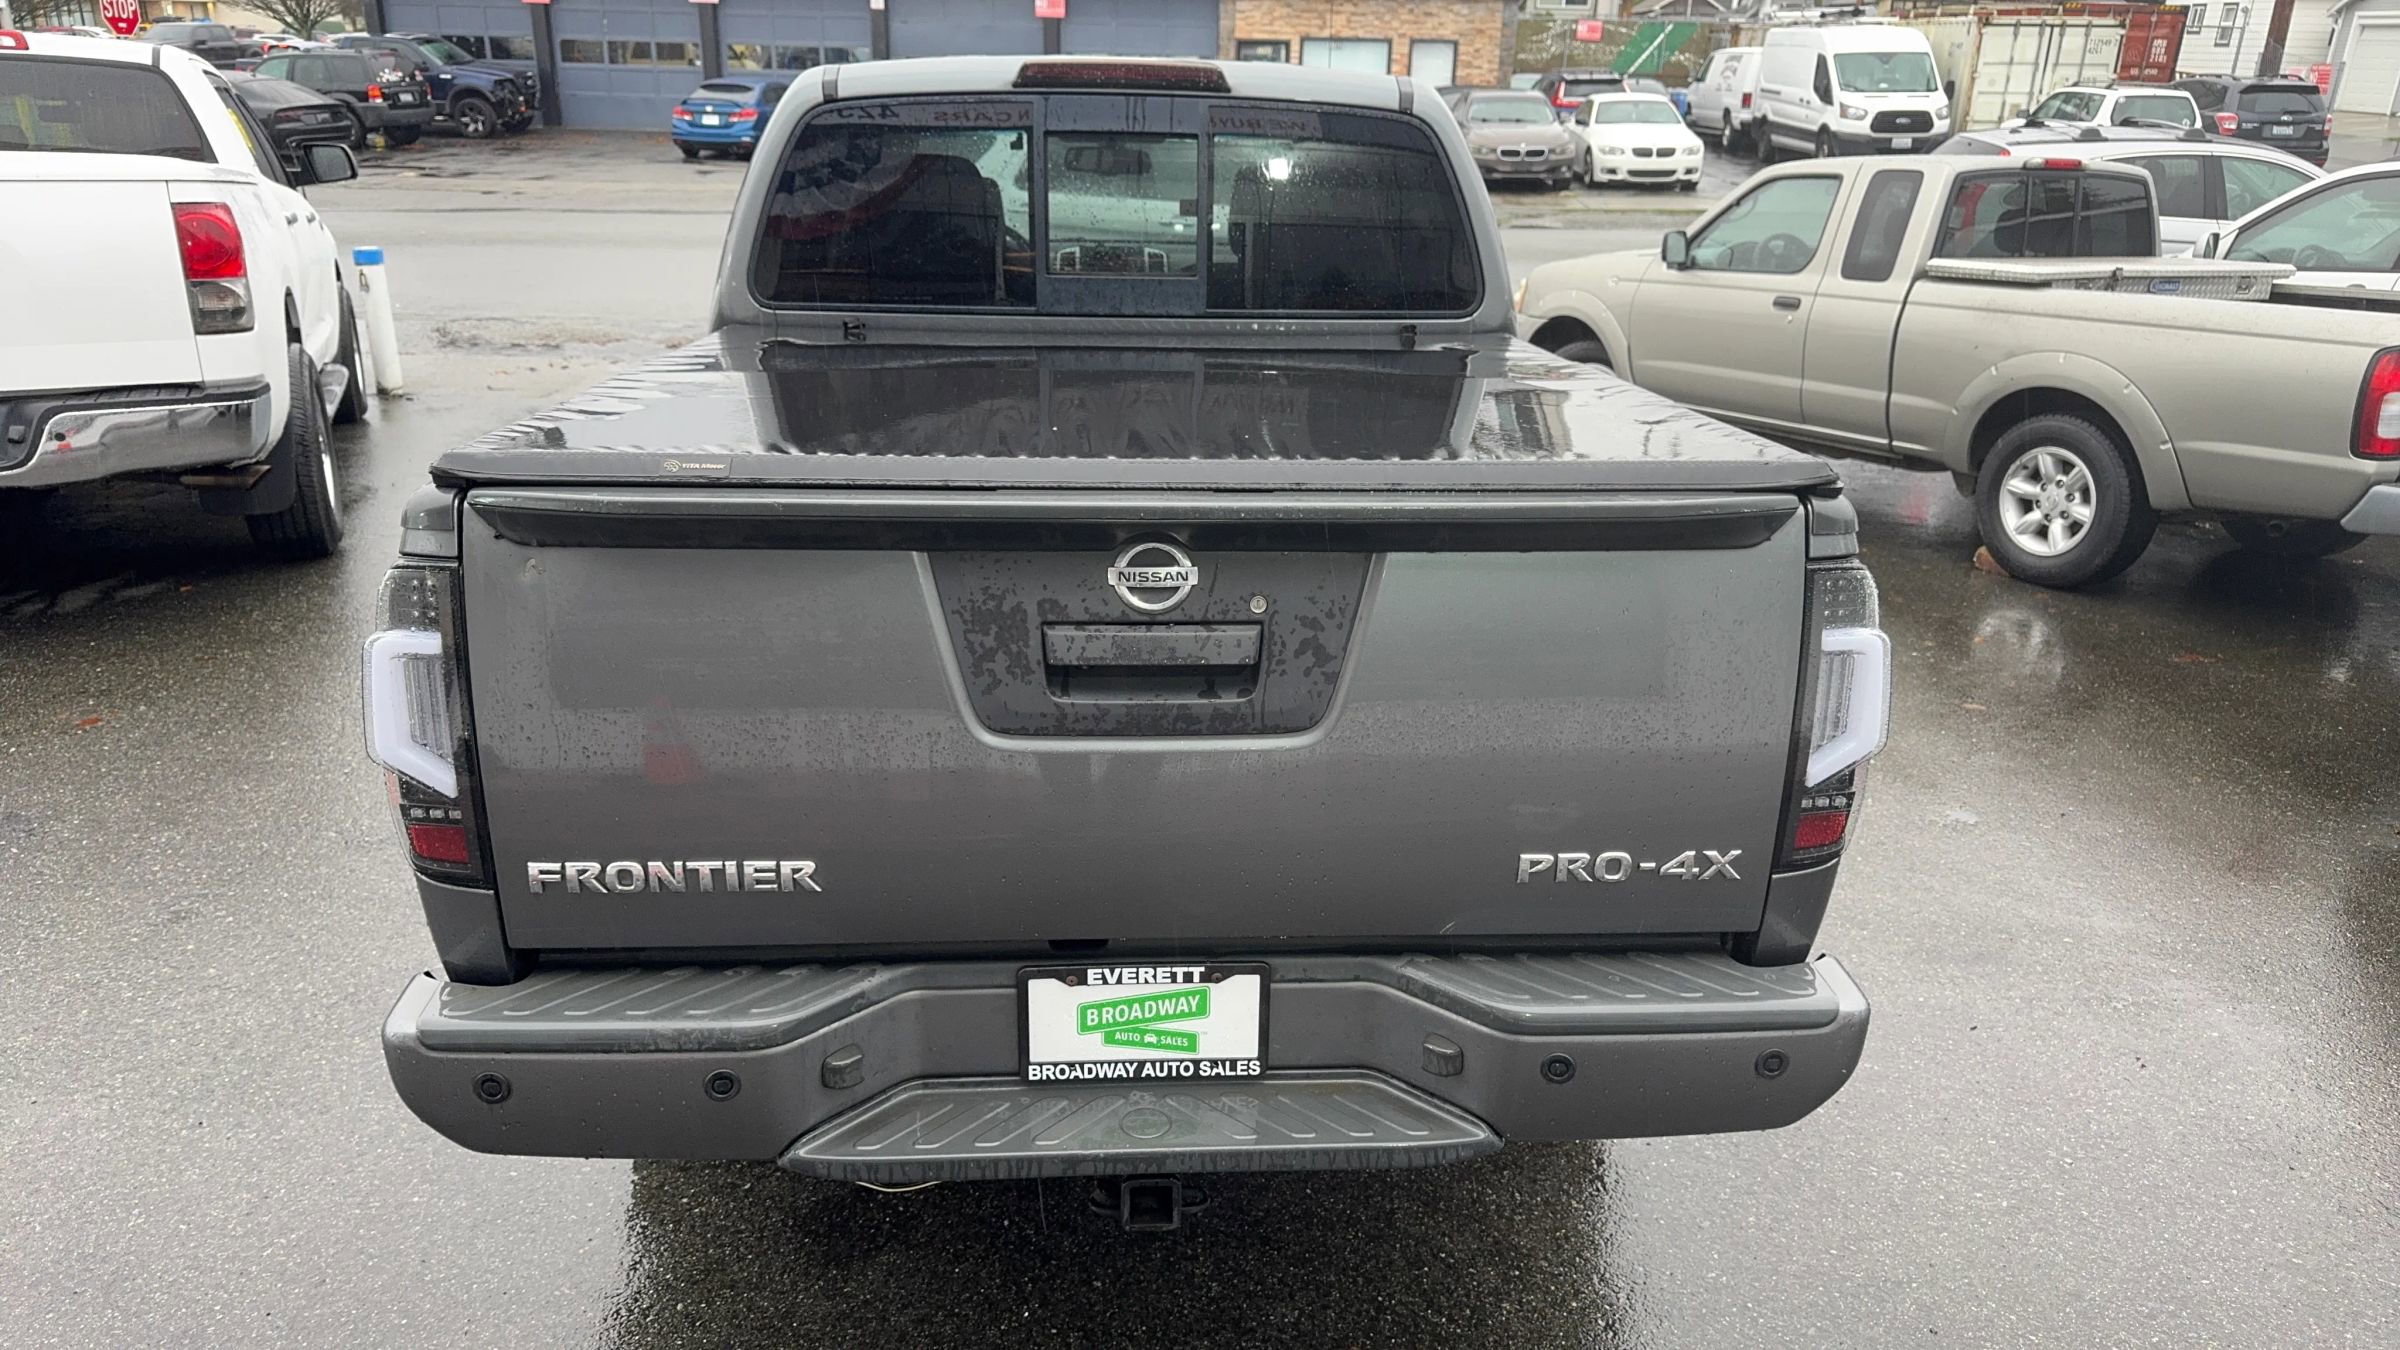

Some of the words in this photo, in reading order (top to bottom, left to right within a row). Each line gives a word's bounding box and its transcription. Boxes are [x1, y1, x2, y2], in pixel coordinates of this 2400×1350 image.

[103, 0, 136, 19] STOP
[1118, 571, 1189, 583] NISSAN
[1516, 849, 1743, 884] PRO-4X
[527, 860, 823, 895] FRONTIER
[1086, 966, 1206, 986] EVERETT
[1086, 994, 1201, 1027] BROADWAY
[1114, 1031, 1141, 1043] AUTO
[1160, 1034, 1189, 1048] SALES
[1028, 1062, 1140, 1082] BROADWAY
[1141, 1061, 1195, 1079] AUTO
[1198, 1060, 1262, 1078] SALES
